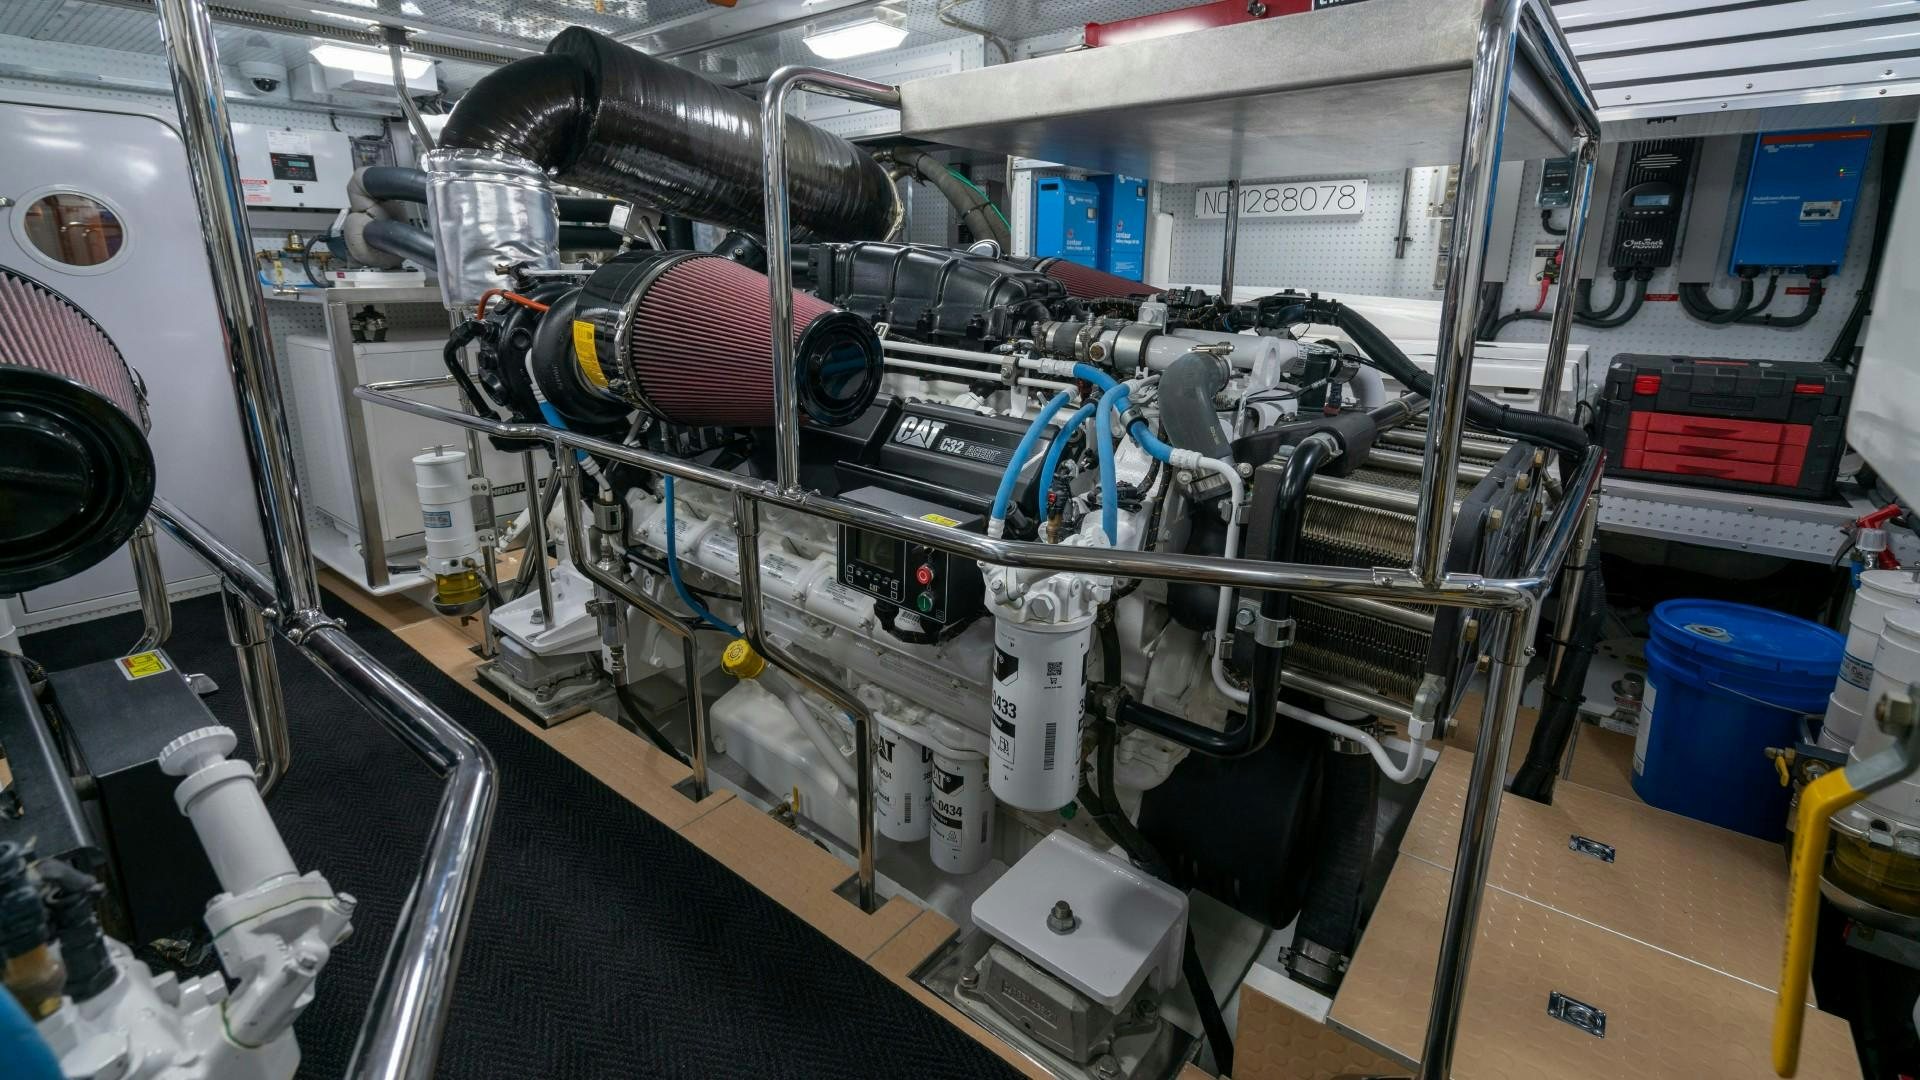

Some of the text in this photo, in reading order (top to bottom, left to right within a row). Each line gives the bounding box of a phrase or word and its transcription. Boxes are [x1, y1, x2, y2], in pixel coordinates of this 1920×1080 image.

[1239, 185, 1356, 214] 1288078
[895, 416, 948, 449] CAT
[939, 437, 965, 454] C32
[879, 736, 896, 763] AT
